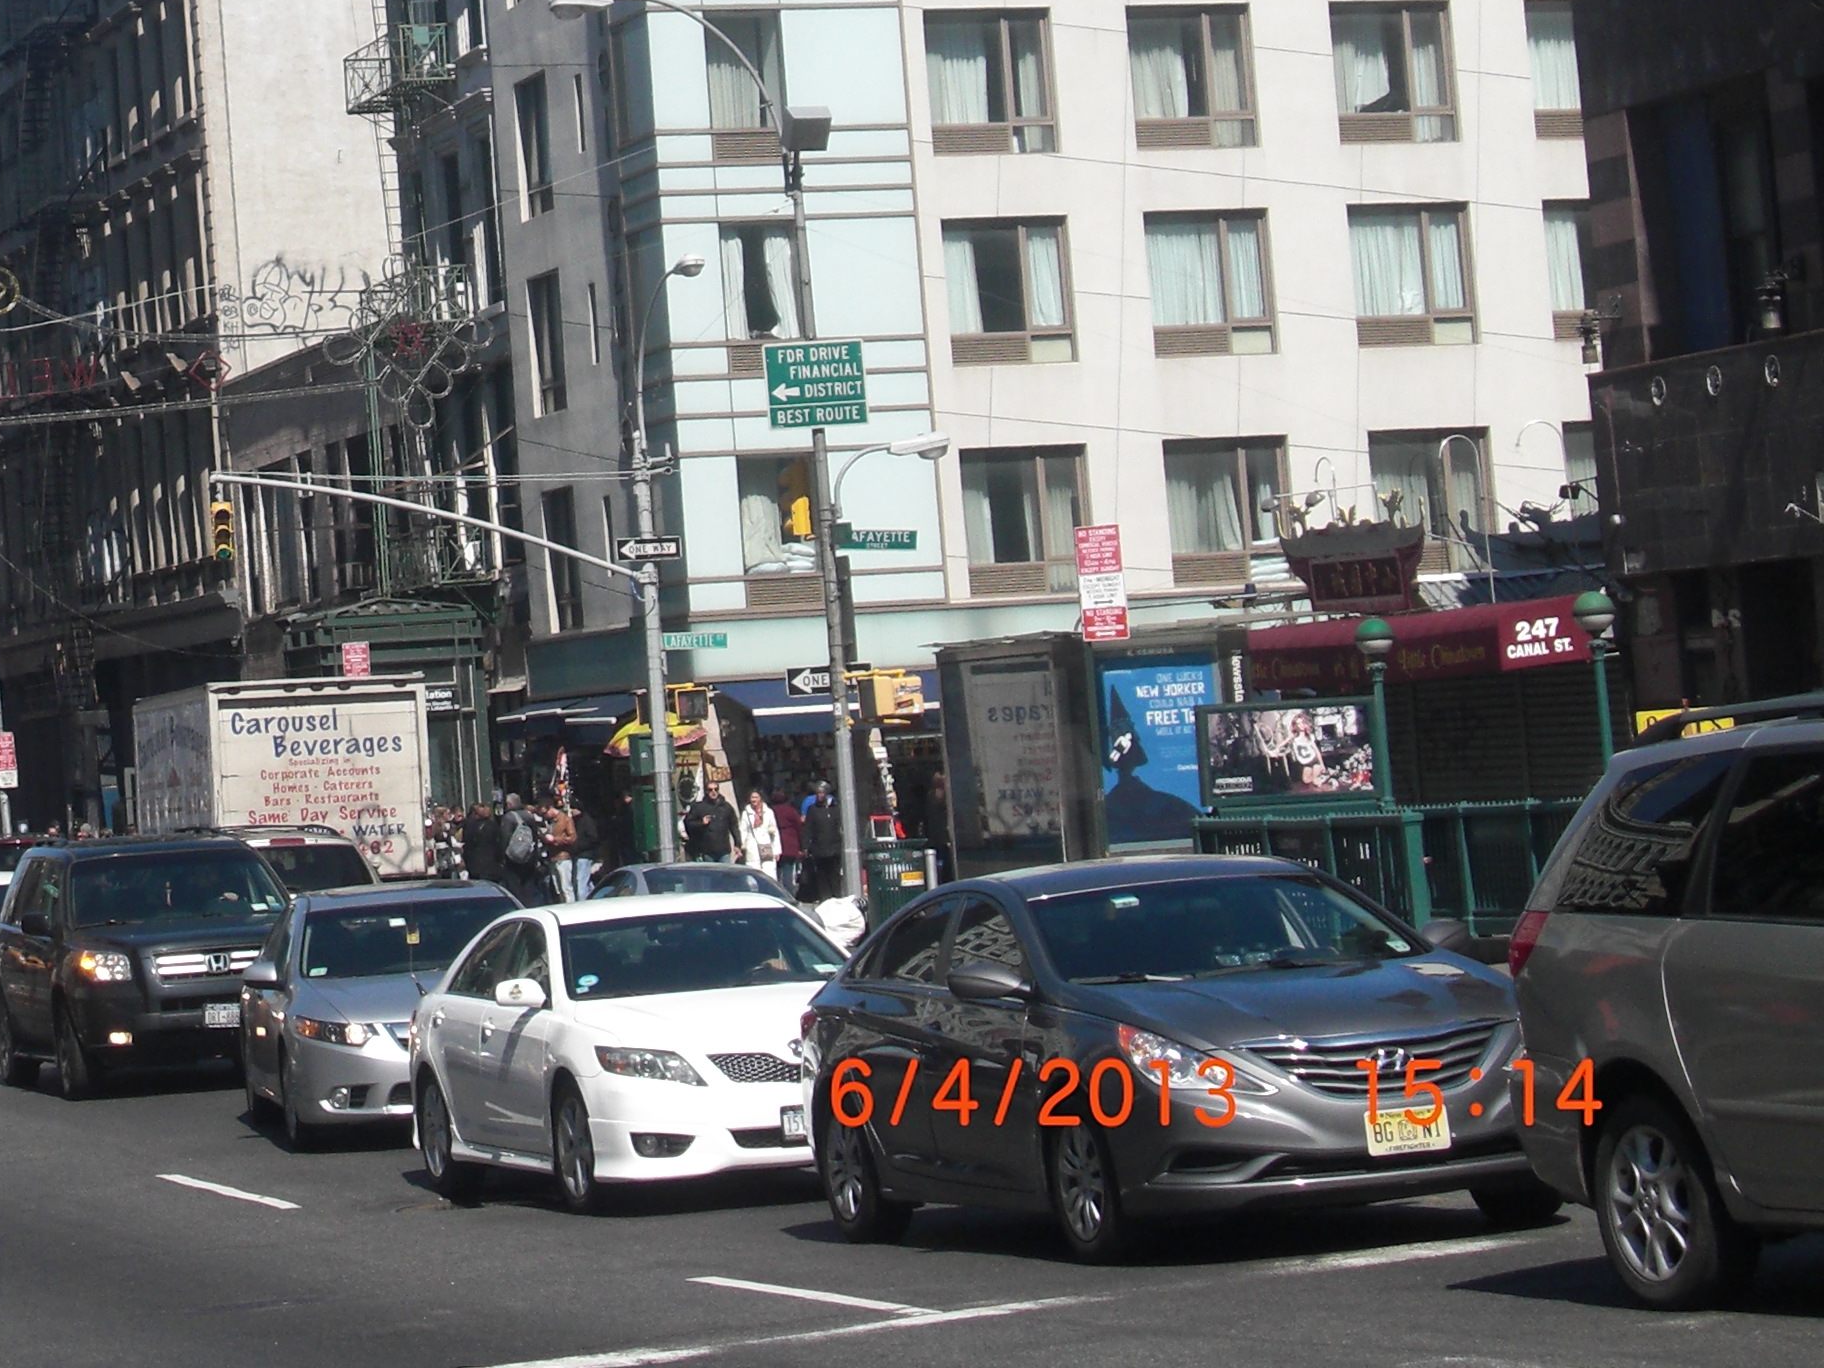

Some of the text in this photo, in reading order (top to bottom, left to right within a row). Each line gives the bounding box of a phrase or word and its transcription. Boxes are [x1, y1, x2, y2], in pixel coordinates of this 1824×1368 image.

[777, 345, 850, 364] FDR DRIVE
[790, 362, 862, 380] FINANCIAL
[804, 381, 863, 398] DISTRICT
[777, 405, 861, 424] BEST ROUTE
[852, 531, 910, 543] AFAYETTE
[1089, 528, 1116, 536] STANDING
[629, 544, 672, 554] ONE WAY
[1514, 616, 1560, 642] 247
[665, 634, 714, 648] LAFAYETTE
[1506, 635, 1575, 660] CANAL ST.
[802, 675, 828, 687] ONE
[1156, 671, 1203, 683] ONE LUCKY
[1136, 682, 1205, 699] NEW YORKER
[231, 708, 339, 736] Carousel
[1146, 709, 1180, 726] FREE
[273, 735, 403, 758] Beverages
[288, 757, 339, 766] Specializing
[260, 765, 381, 782] Corporate Accounts
[273, 780, 373, 794] Homes Caterers
[264, 792, 380, 807] Bars Restaurants
[248, 805, 398, 826] Same Day Service
[352, 823, 407, 838] WATER
[1373, 1121, 1394, 1144] BG
[1388, 1142, 1431, 1152] FIREFIGHTER
